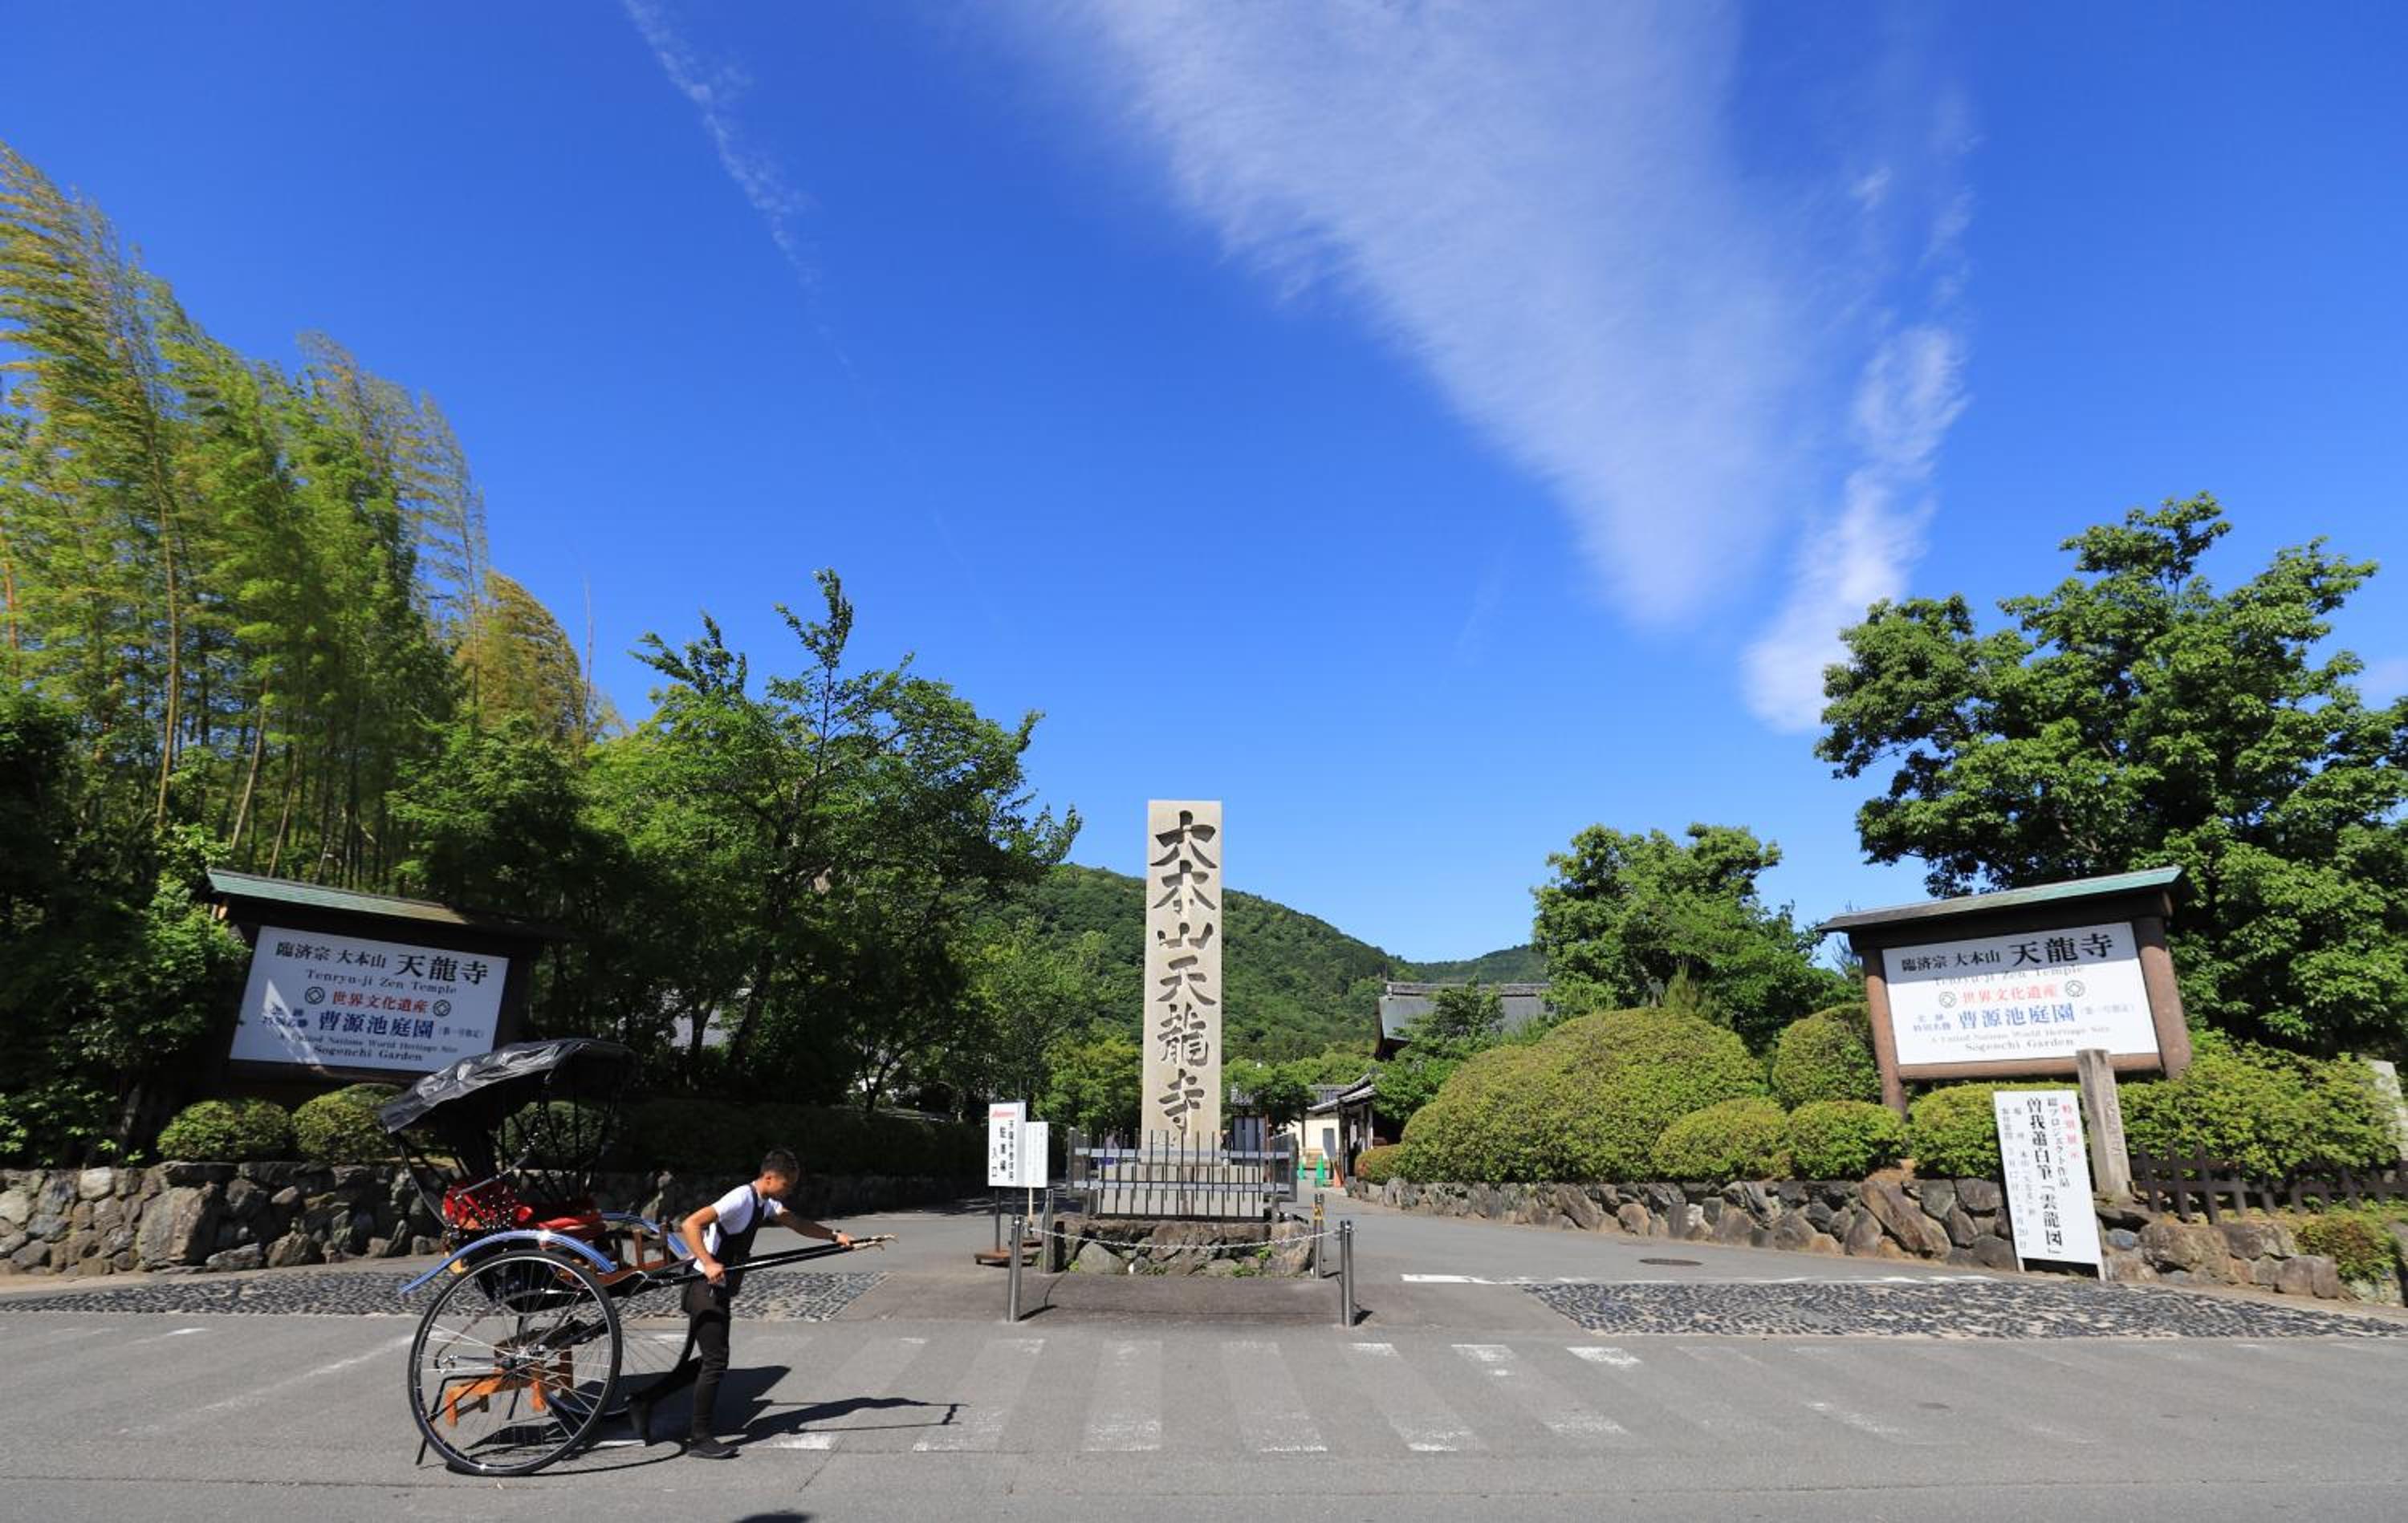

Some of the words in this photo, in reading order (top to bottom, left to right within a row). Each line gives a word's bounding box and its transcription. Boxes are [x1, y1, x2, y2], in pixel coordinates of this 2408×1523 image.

[1954, 949, 2000, 966] 大本山
[2008, 932, 2113, 967] 天龍寺
[276, 941, 331, 961] 臨済宗
[336, 948, 386, 969] 大本山
[394, 954, 488, 985] 天龍寺
[1150, 810, 1218, 1137] 大本山天龍寺
[306, 969, 372, 987] Tenryu-ji
[379, 977, 404, 989] Zen
[411, 980, 457, 995] Temple
[1963, 985, 2056, 1003] 世界文化遺産
[333, 991, 429, 1013] 世界文化遺産
[379, 1050, 423, 1062] Garden
